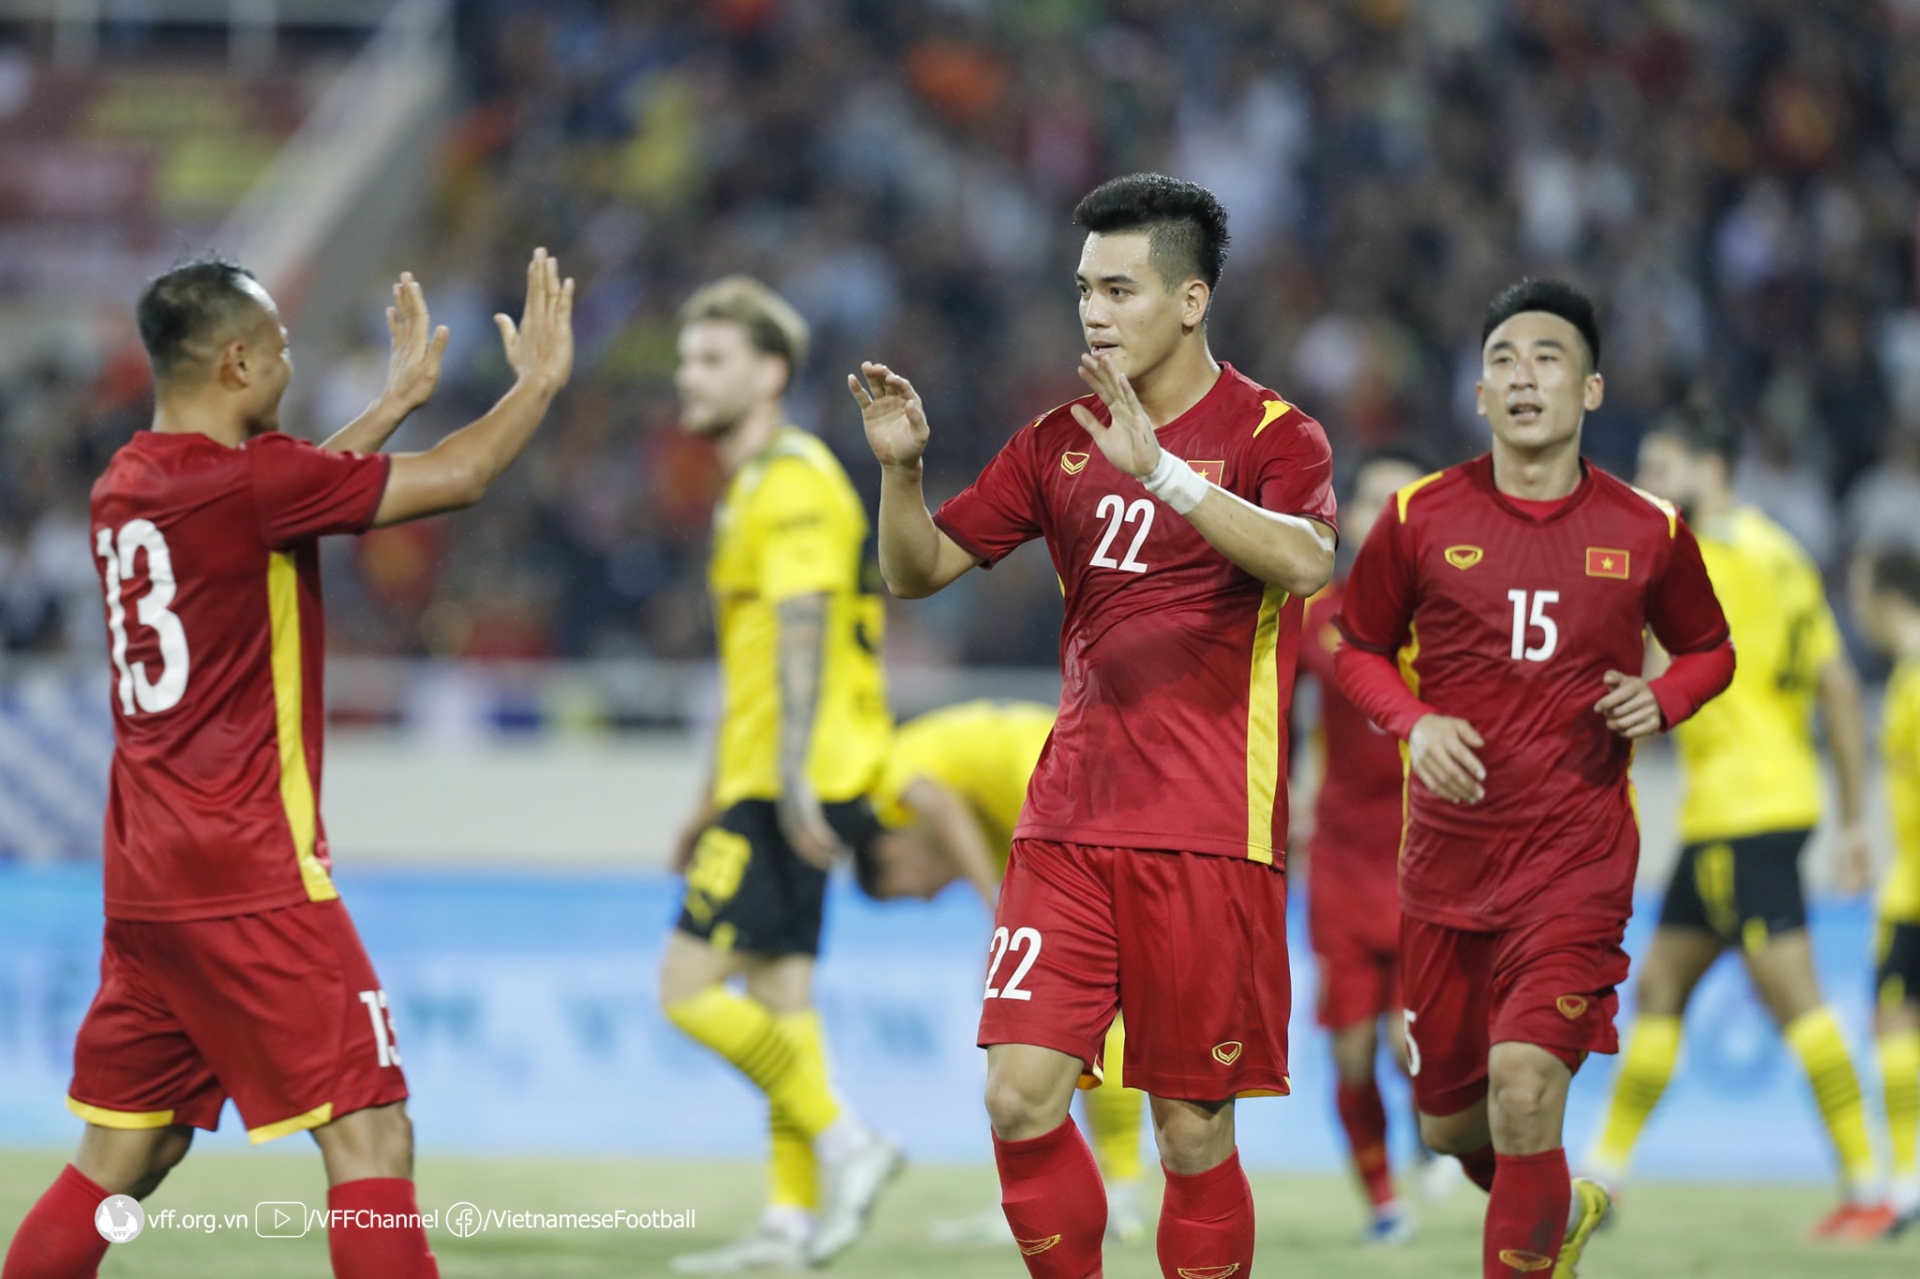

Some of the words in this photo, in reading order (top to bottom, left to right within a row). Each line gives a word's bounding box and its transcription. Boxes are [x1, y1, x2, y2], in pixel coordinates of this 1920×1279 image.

[1089, 494, 1155, 573] 22
[97, 518, 190, 715] 13
[1507, 588, 1560, 662] 15
[983, 926, 1043, 1001] 22
